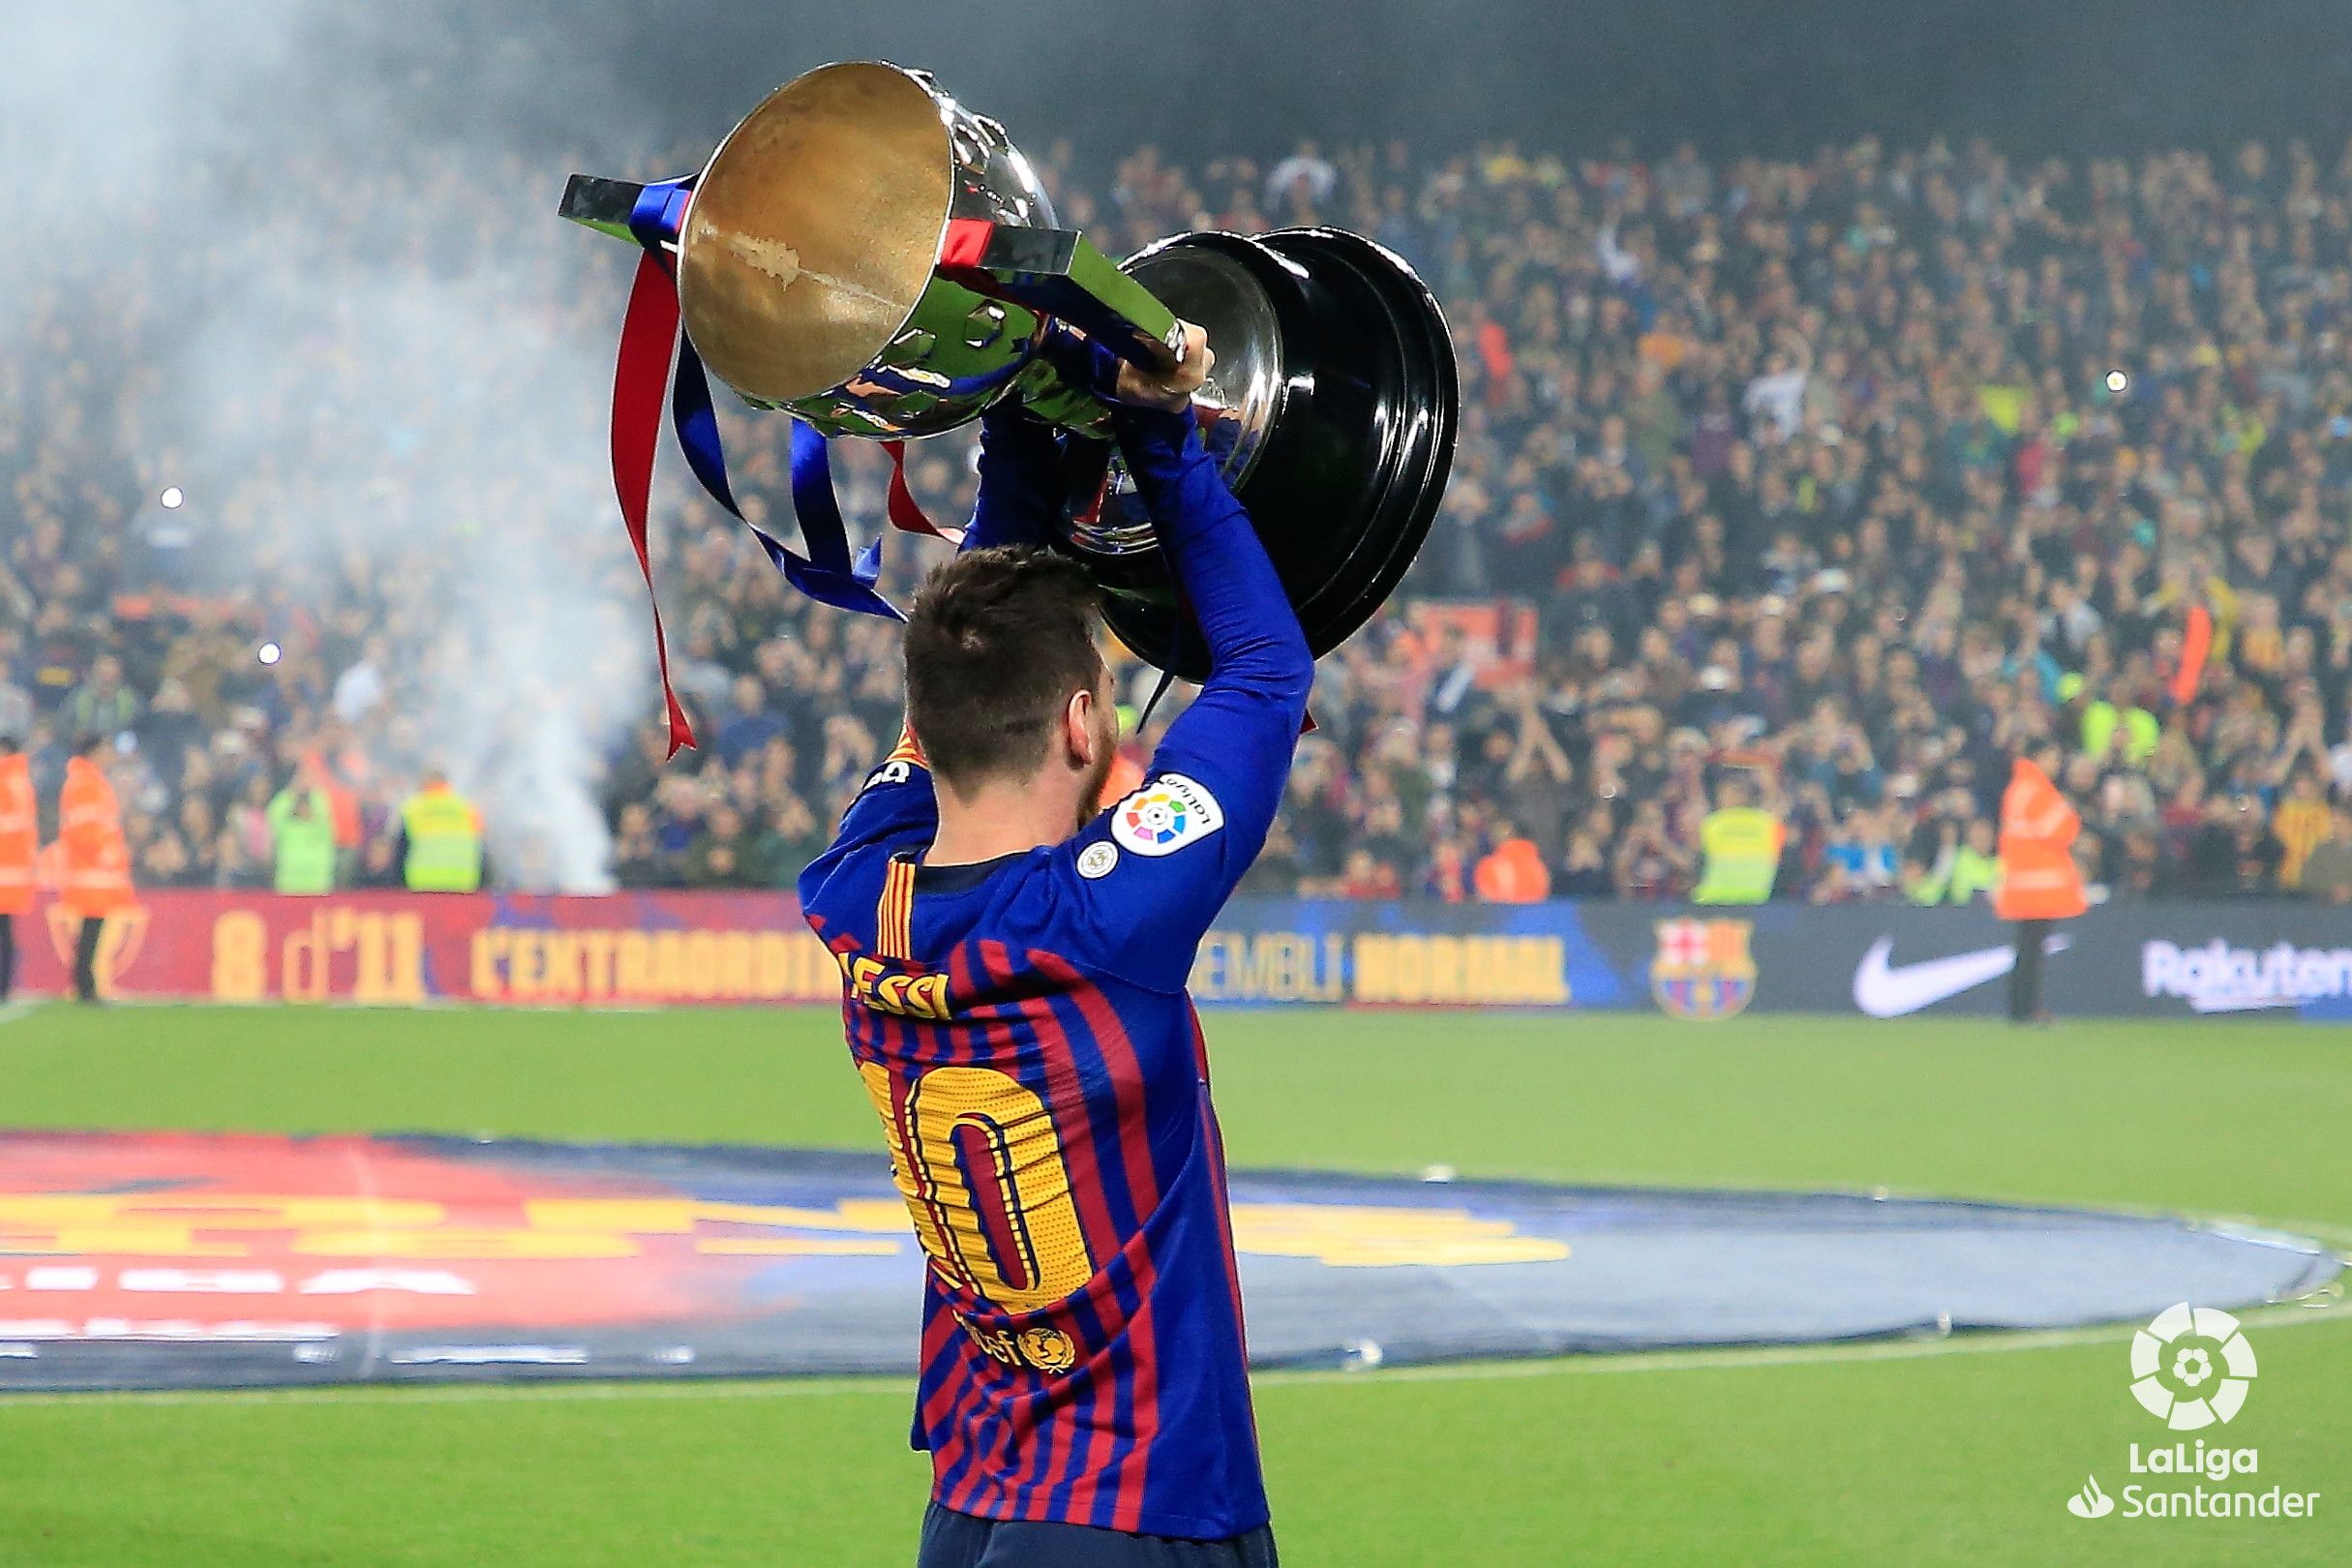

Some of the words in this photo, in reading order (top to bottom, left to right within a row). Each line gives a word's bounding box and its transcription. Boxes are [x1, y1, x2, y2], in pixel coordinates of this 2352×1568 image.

[212, 908, 266, 1003] 8
[1356, 934, 1570, 1004] NORMAL
[2142, 939, 2352, 999] Rakuten
[858, 1060, 1093, 1315] 10
